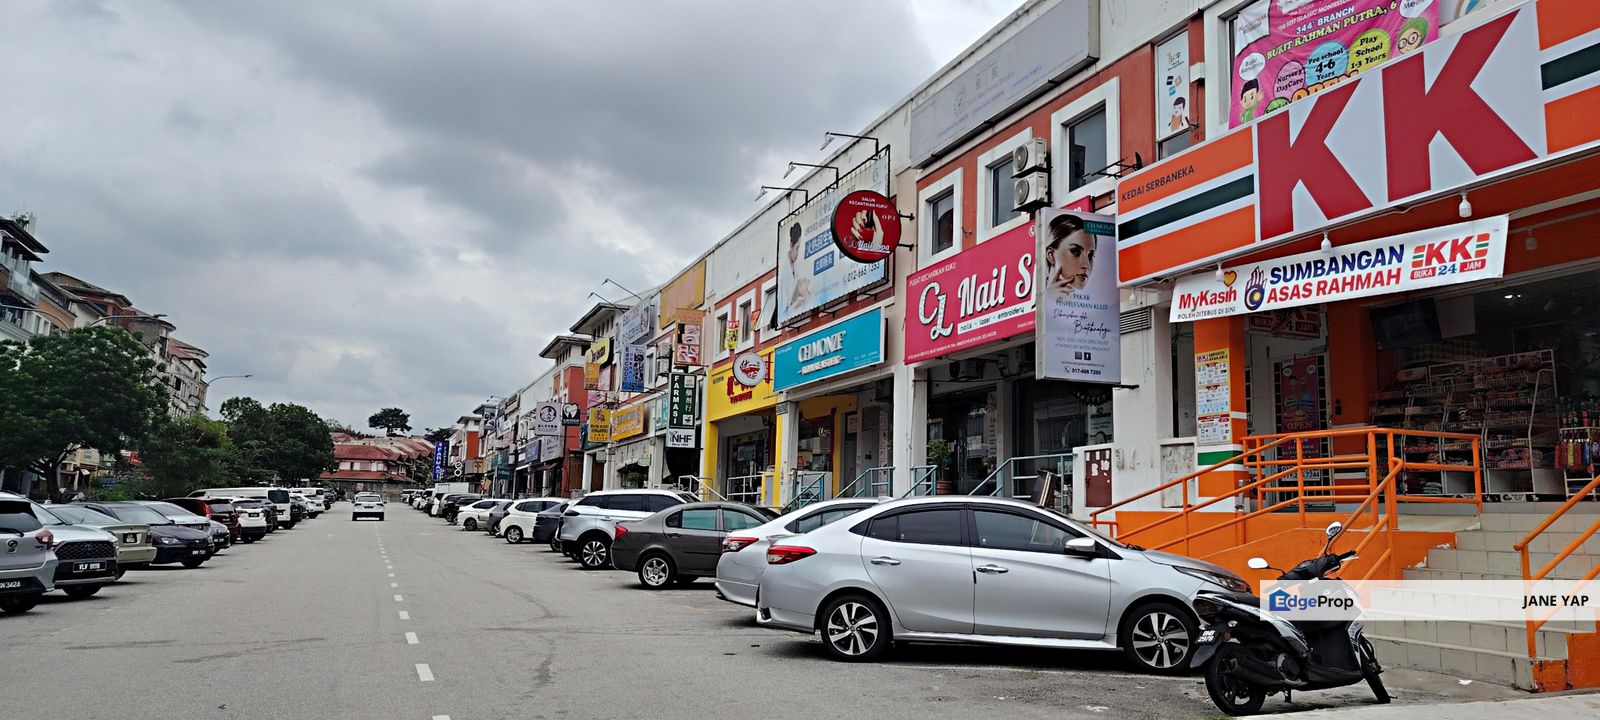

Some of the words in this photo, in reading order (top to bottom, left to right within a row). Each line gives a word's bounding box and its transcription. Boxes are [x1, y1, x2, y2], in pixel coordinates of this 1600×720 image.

[1297, 10, 1317, 22] ISLAMIC
[1317, 5, 1355, 26] BRANCH
[1266, 39, 1293, 60] BUKIT
[1294, 21, 1341, 48] RAHMAN
[1343, 5, 1388, 30] PUTRA,
[1390, 1, 1397, 10] 6
[1360, 35, 1377, 46] Play
[1308, 56, 1321, 64] Pre
[1321, 47, 1344, 60] school
[1355, 43, 1383, 57] School
[1315, 58, 1335, 73] 4-6
[1350, 61, 1362, 69] 1-3
[1365, 52, 1386, 65] Years
[1316, 71, 1335, 81] Years
[1276, 78, 1304, 93] DayCare
[1257, 8, 1540, 241] KK
[1122, 185, 1145, 202] KEDAI
[1145, 165, 1195, 192] SERBANEKA
[1425, 235, 1474, 267] KK
[1270, 243, 1405, 286] SUMBANGAN
[1413, 268, 1433, 279] BUKA
[1437, 263, 1458, 277] 24
[1463, 261, 1482, 272] JAM
[958, 264, 1007, 319] Nail
[1267, 281, 1312, 303] ASAS
[1315, 266, 1402, 297] RAHMAH
[1073, 293, 1090, 301] PAKAR
[1178, 286, 1238, 312] MyKasih
[1177, 312, 1196, 320] BOLEH
[1196, 310, 1217, 319] DITEBUS
[1286, 420, 1312, 430] OPEN
